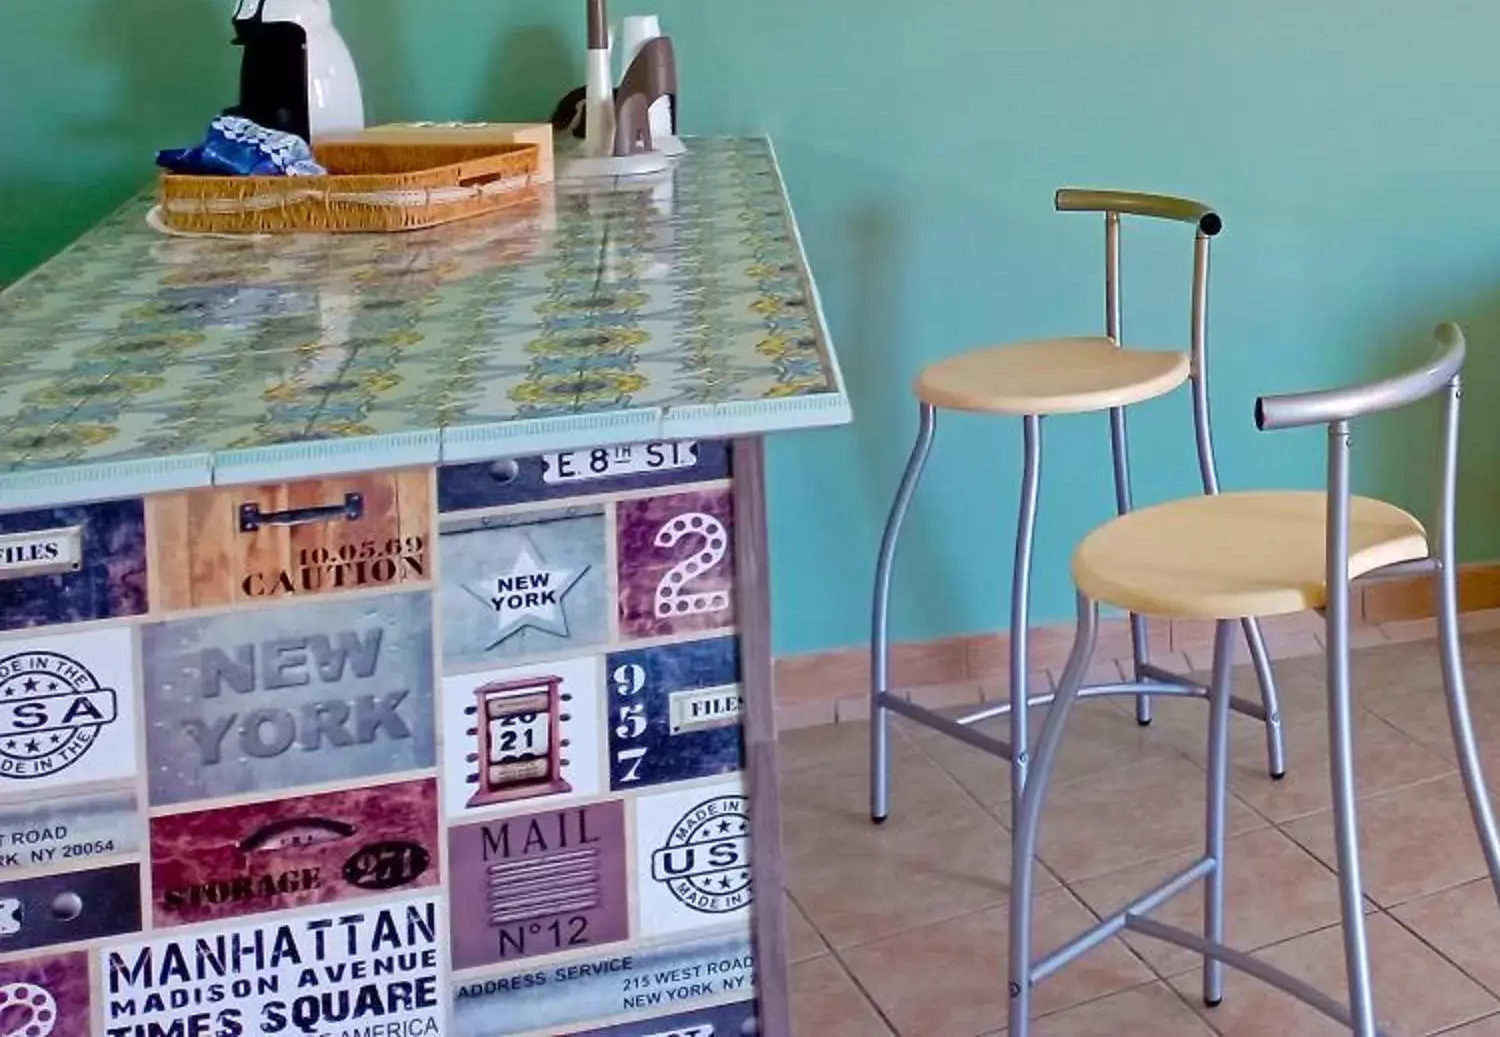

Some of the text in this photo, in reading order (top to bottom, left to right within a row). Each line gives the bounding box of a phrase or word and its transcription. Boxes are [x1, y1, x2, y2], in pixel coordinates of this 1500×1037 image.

[300, 535, 423, 565] 10.05.69
[654, 513, 729, 618] 2
[242, 554, 425, 598] CAUTION
[497, 572, 550, 592] NEW
[490, 589, 557, 612] YORK
[29, 657, 49, 669] IN
[56, 660, 88, 687] THE
[200, 627, 384, 699] NEW
[180, 689, 412, 765] YORK
[500, 728, 534, 752] 21
[34, 757, 53, 772] IN
[58, 730, 91, 760] THE
[11, 826, 67, 845] ROAD
[481, 808, 600, 861] MAIL
[675, 801, 740, 842] MADE IN
[31, 848, 56, 862] NY
[62, 840, 114, 858] 20054
[164, 868, 322, 909] STORAGE
[677, 882, 742, 910] MADE IN
[108, 902, 436, 994] MANHATTAN
[500, 915, 590, 958] N°12
[111, 948, 437, 1019] MADISON AVENUE
[457, 956, 634, 1000] ADDRESS SERVICE
[623, 955, 754, 992] 215 WEST ROAD
[623, 990, 661, 1009] NEW
[666, 980, 713, 1001] YORK
[722, 975, 744, 991] NY
[259, 975, 438, 1034] SQUARE
